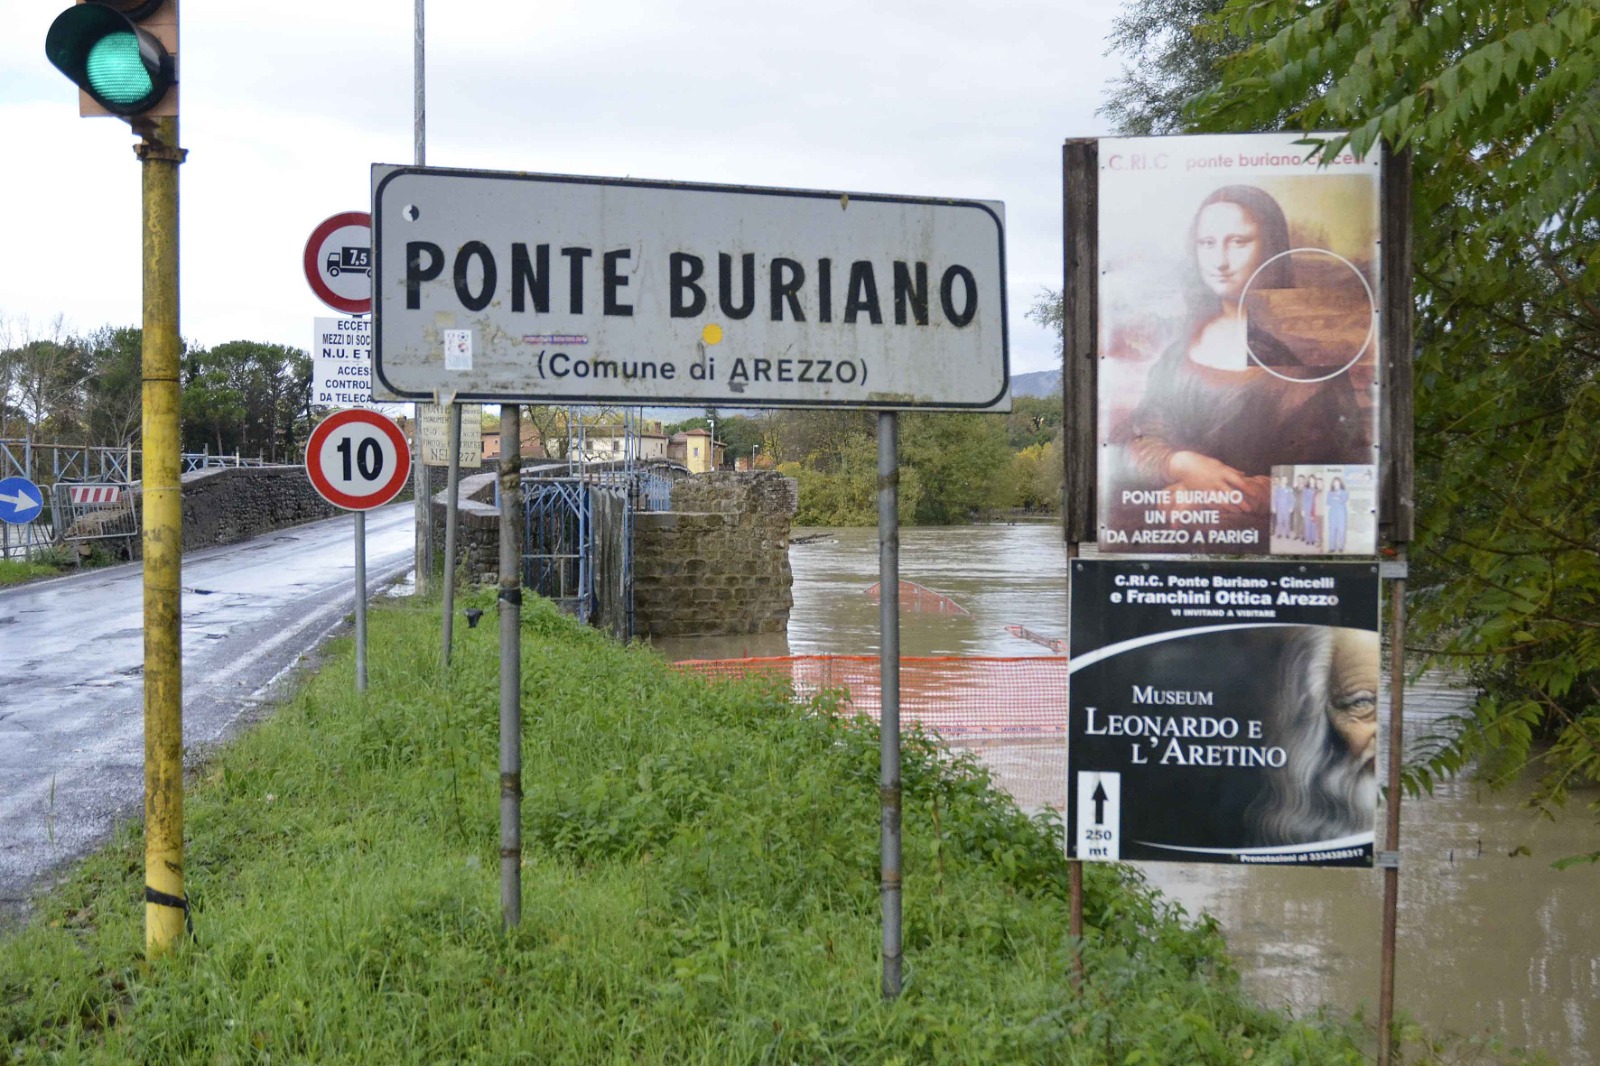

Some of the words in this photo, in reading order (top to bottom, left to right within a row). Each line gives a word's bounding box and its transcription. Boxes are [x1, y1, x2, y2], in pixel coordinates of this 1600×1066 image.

[1186, 154, 1233, 171] ponte
[1238, 152, 1301, 167] buriano
[350, 249, 367, 266] 7,5
[406, 240, 633, 317] PONTE
[669, 251, 978, 328] BURIANO
[338, 321, 371, 331] ECCET
[323, 334, 344, 345] MEZZI
[346, 335, 354, 346] DI
[323, 348, 348, 359] N.U.
[353, 349, 361, 359] E
[338, 366, 371, 376] ACCES
[538, 350, 675, 379] (Comune
[689, 357, 715, 380] di
[729, 357, 868, 385] AREZZO)
[320, 392, 333, 402] DA
[337, 437, 384, 481] 10
[1122, 490, 1170, 504] PONTE
[1175, 490, 1243, 504] BURIANO
[1145, 510, 1166, 524] UN
[1171, 510, 1220, 524] PONTE
[1106, 530, 1128, 543] DA
[1131, 530, 1190, 544] AREZZO
[1192, 530, 1205, 543] A
[1168, 575, 1210, 588] Ponte
[1212, 576, 1269, 588] Buriano
[1279, 576, 1335, 589] Cincelli
[1110, 591, 1123, 604] e
[1126, 589, 1211, 605] Franchini
[1215, 590, 1273, 606] Ottica
[1276, 591, 1340, 607] Arezzo
[1170, 608, 1182, 617] VI
[1183, 608, 1225, 617] INVITANO
[1226, 609, 1235, 618] A
[1132, 685, 1214, 706] MUSEUM
[1085, 706, 1239, 739] LEONARDO
[1247, 720, 1263, 739] E
[1086, 829, 1112, 840] 250
[1089, 847, 1107, 857] mt
